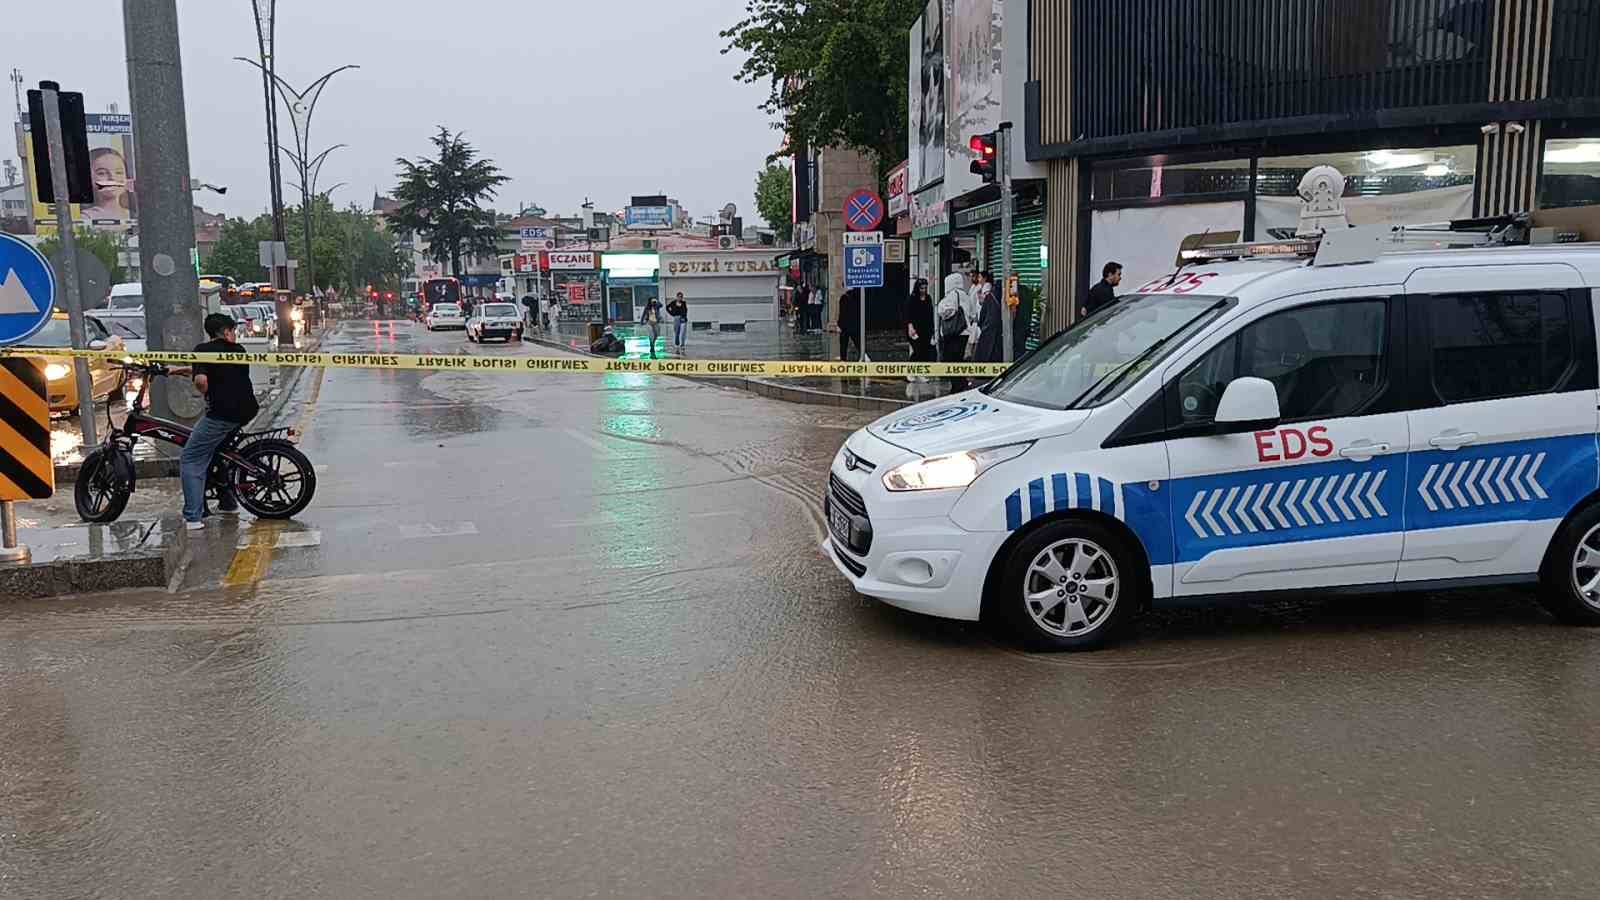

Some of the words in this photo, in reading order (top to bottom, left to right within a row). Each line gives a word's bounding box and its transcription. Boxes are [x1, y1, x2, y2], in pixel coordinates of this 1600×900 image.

[551, 254, 592, 263] ECZANE
[1136, 272, 1219, 293] EDS
[1254, 426, 1333, 462] EDS
